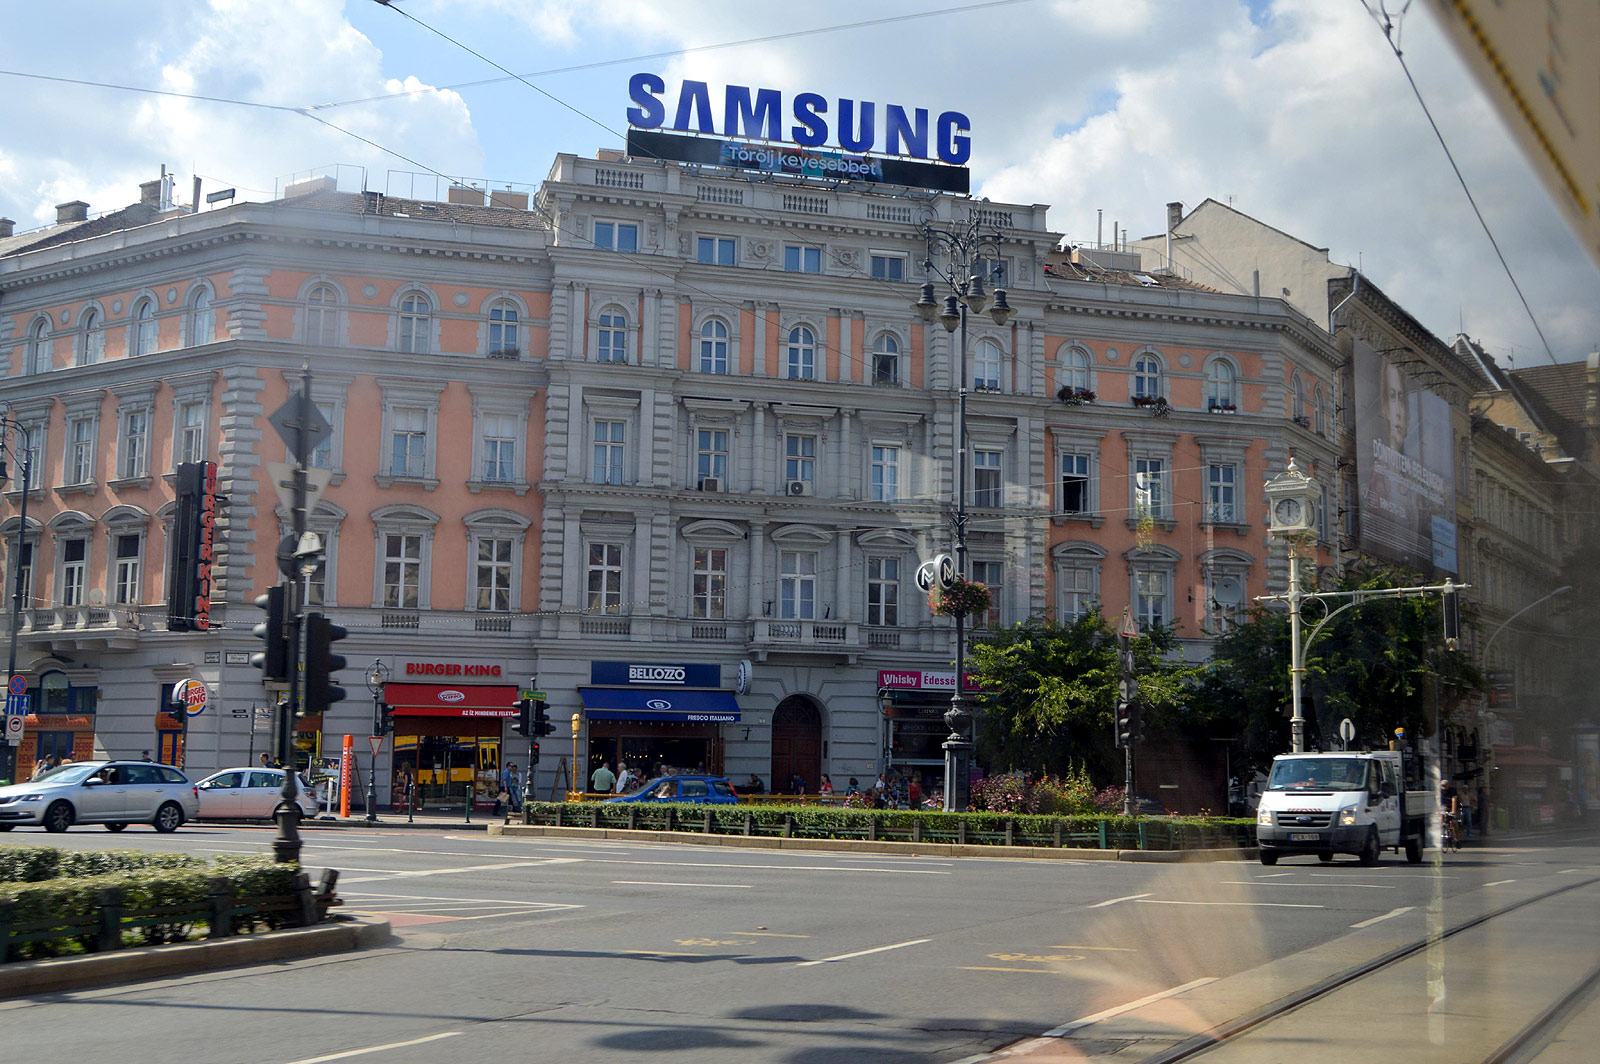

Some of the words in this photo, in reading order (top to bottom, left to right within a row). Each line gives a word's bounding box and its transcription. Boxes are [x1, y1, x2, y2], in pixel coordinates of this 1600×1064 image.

[626, 73, 971, 165] SAMSUNG
[729, 146, 774, 168] Törölj
[778, 153, 876, 175] kevesebbet
[199, 462, 217, 561] BURGER
[196, 563, 211, 631] KING
[406, 663, 462, 676] BURGER
[464, 665, 502, 677] KING
[629, 668, 685, 680] BELLOZZO
[883, 674, 917, 686] Whisky
[924, 673, 956, 686] Édessé
